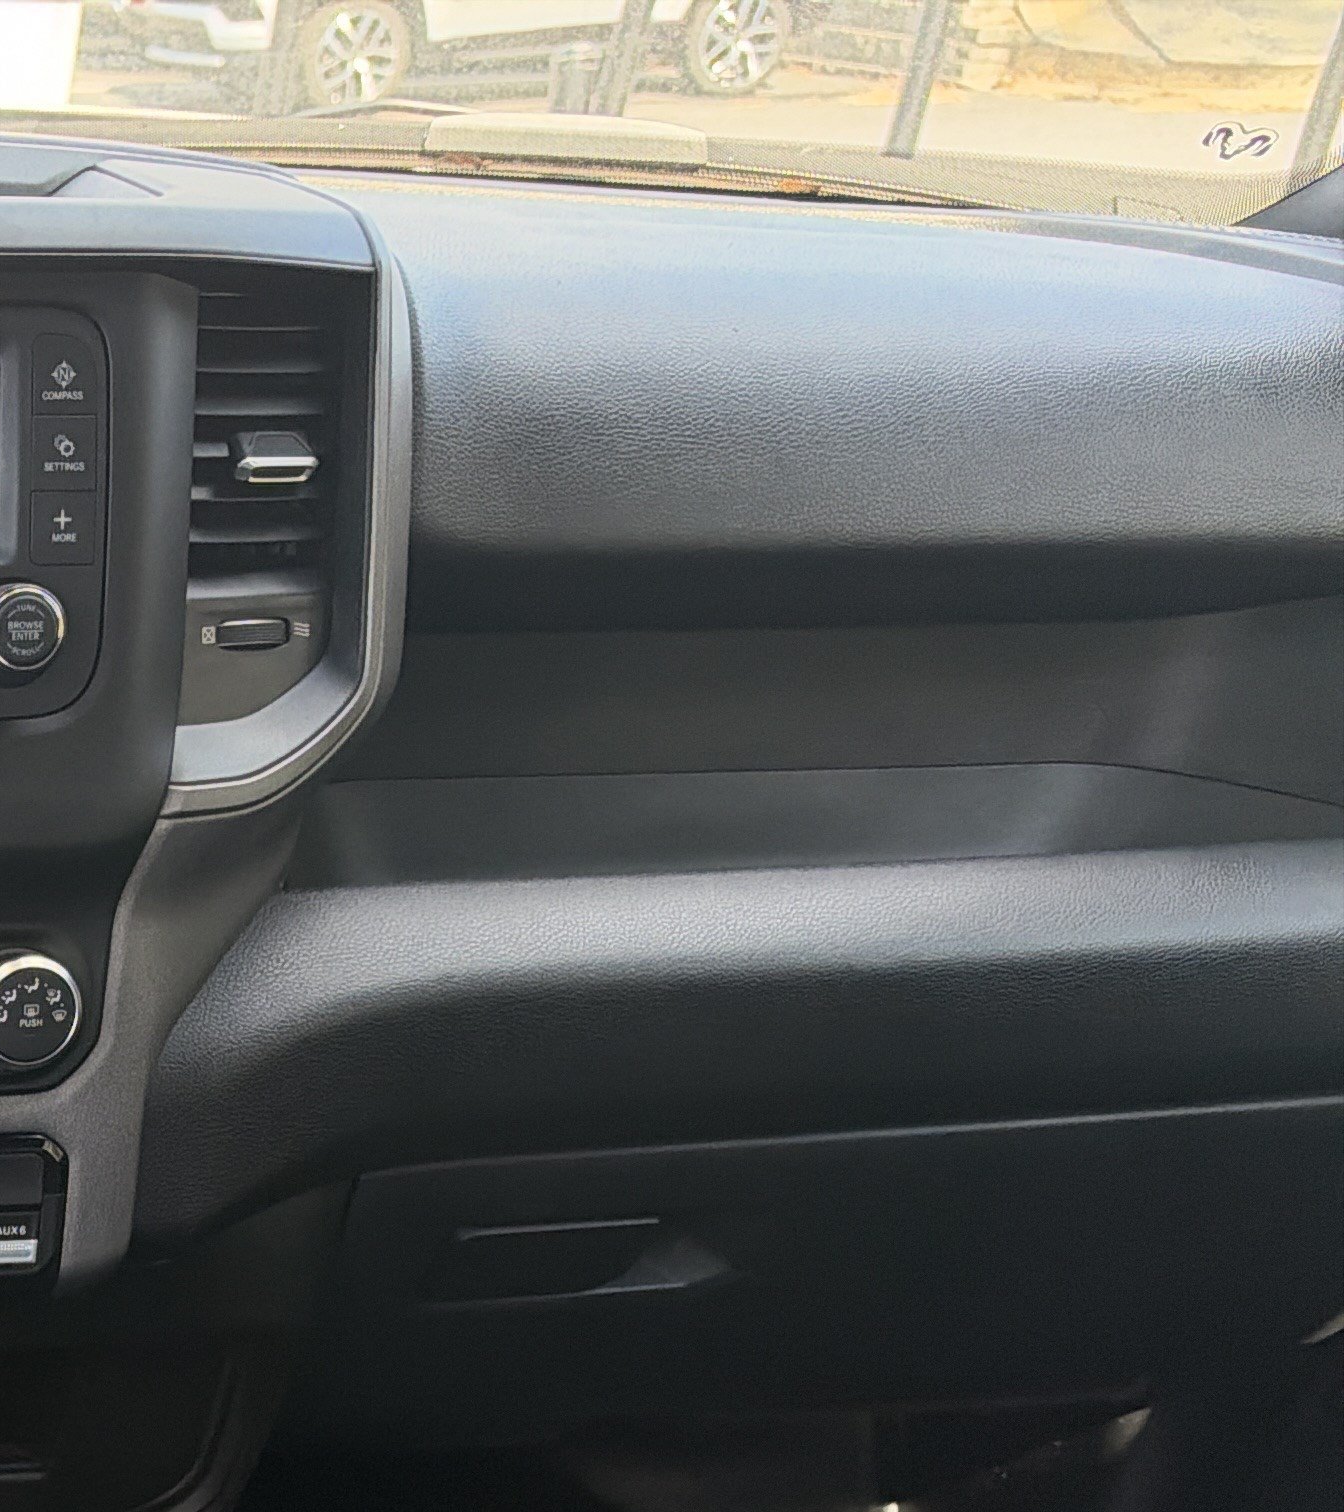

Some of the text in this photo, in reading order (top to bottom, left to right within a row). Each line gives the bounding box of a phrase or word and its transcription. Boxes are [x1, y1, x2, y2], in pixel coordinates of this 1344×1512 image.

[42, 391, 83, 400] COMPASS
[43, 461, 85, 471] SETTINGS
[51, 533, 77, 542] MORE
[8, 621, 44, 630] BROWSE
[12, 632, 40, 641] ENTER
[19, 1019, 43, 1028] PUSH
[19, 1225, 26, 1235] 6
